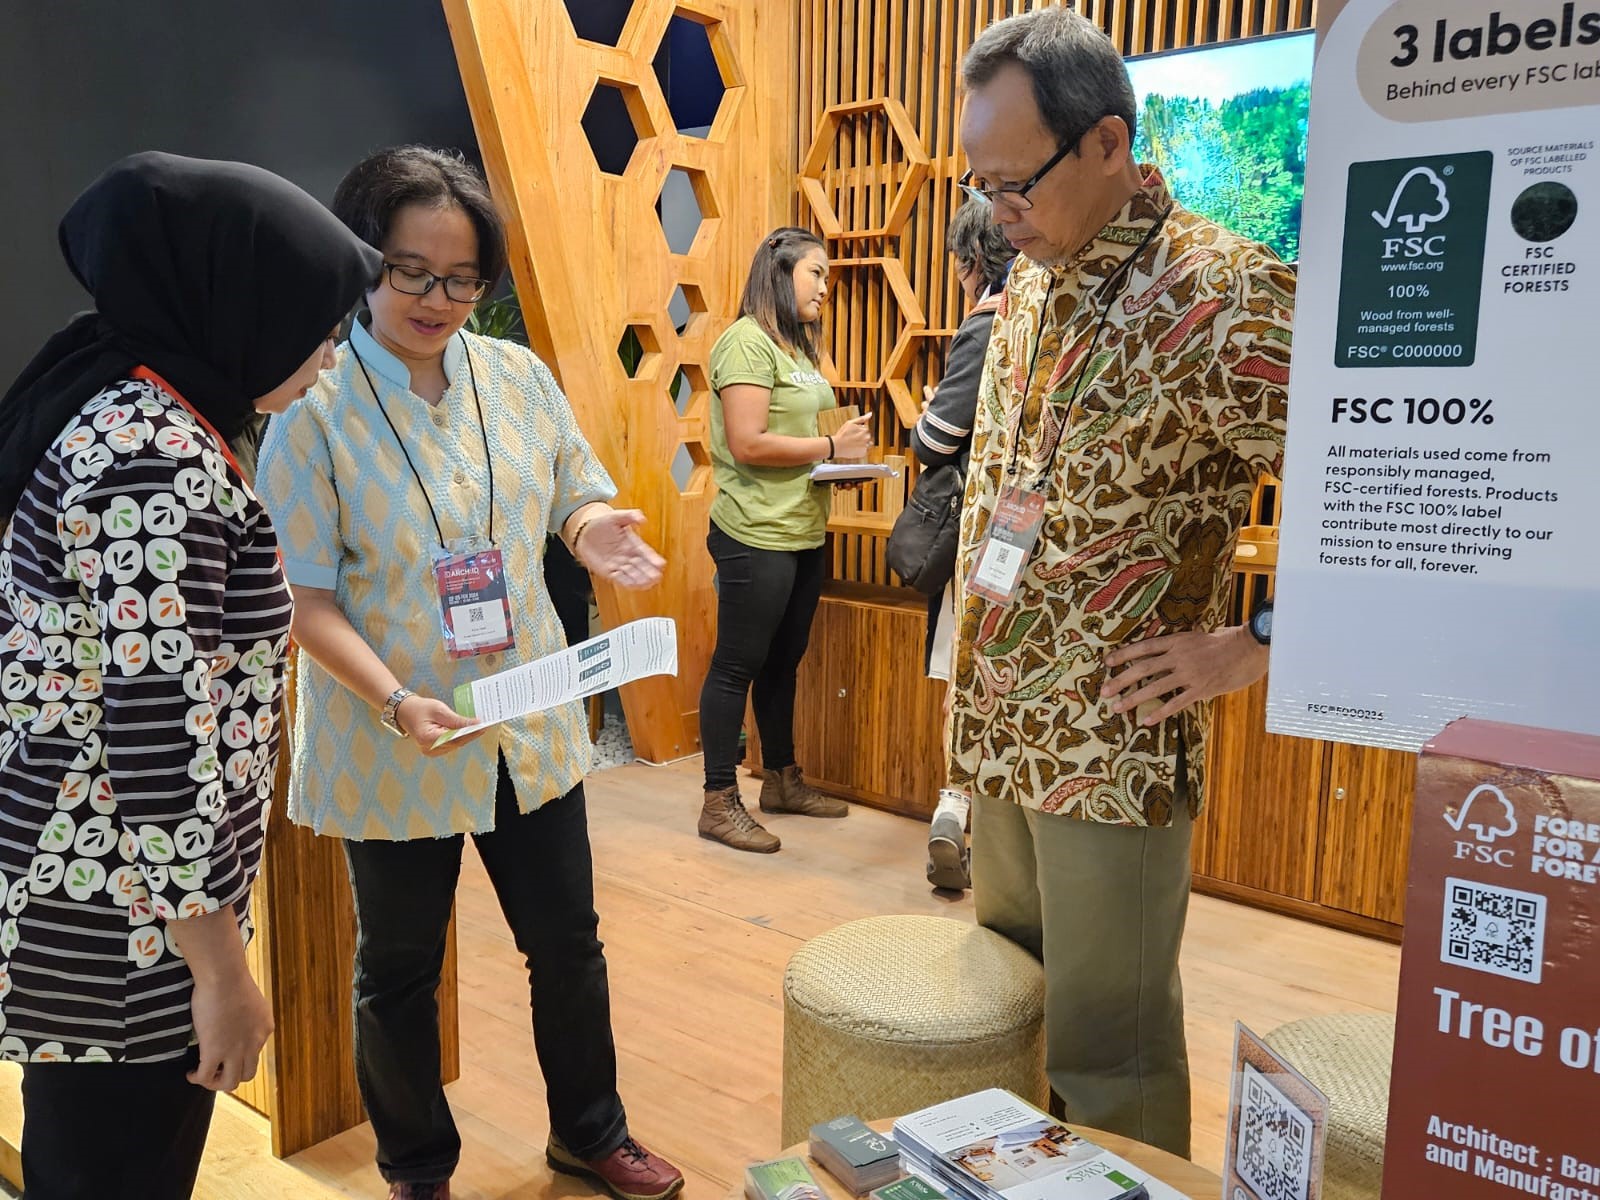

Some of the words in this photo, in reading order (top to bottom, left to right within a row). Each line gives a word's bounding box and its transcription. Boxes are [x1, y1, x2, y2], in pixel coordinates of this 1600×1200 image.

[1390, 25, 1418, 67] 3
[1434, 2, 1600, 62] labels
[1387, 77, 1456, 100] Behind
[1461, 73, 1520, 92] every
[1526, 64, 1567, 84] FSC
[1508, 146, 1542, 155] SOURCE
[1545, 142, 1593, 152] MATERIALS
[1510, 158, 1522, 166] OF
[1544, 153, 1586, 163] LABELLED
[1524, 165, 1572, 174] PRODUCTS
[1382, 236, 1445, 258] FSC
[1526, 247, 1553, 258] FSC
[1381, 261, 1444, 271] www.fsc.org
[1502, 263, 1575, 276] CERTIFIED
[1389, 285, 1429, 298] 100%
[1504, 280, 1568, 293] FORESTS
[1361, 311, 1392, 320] Wood
[1397, 310, 1422, 319] from
[1426, 309, 1454, 318] well-
[1358, 323, 1410, 334] managed
[1415, 322, 1454, 332] forests
[1393, 345, 1462, 357] C000000
[1332, 398, 1394, 423] FSC
[1404, 398, 1493, 424] 100%
[1328, 446, 1346, 457] All
[1350, 447, 1419, 459] materials
[1424, 448, 1460, 460] used
[1465, 452, 1508, 461] come
[1513, 449, 1550, 462] from
[1326, 465, 1410, 480] responsibly
[1415, 468, 1494, 482] managed,
[1325, 482, 1422, 496] FSC-certified
[1427, 485, 1481, 498] forests.
[1486, 487, 1558, 502] Products
[1324, 500, 1354, 511] with
[1360, 501, 1382, 512] the
[1387, 502, 1414, 514] FSC
[1420, 503, 1457, 516] 100%
[1462, 505, 1501, 518] label
[1322, 519, 1397, 531] contribute
[1401, 524, 1437, 534] most
[1442, 523, 1500, 540] directly
[1506, 528, 1521, 538] to
[1526, 530, 1552, 540] our
[1321, 536, 1373, 548] mission
[1378, 539, 1392, 550] to
[1396, 542, 1446, 553] ensure
[1452, 542, 1512, 560] thriving
[1320, 552, 1366, 566] forests
[1372, 556, 1391, 567] for
[1395, 558, 1416, 570] all,
[1421, 558, 1477, 574] forever.
[1454, 841, 1514, 867] FSC
[1533, 835, 1584, 860] FOR
[1532, 855, 1600, 883] FORE
[1434, 987, 1543, 1056] Tree
[1427, 1115, 1540, 1168] Architect
[1426, 1144, 1468, 1172] and
